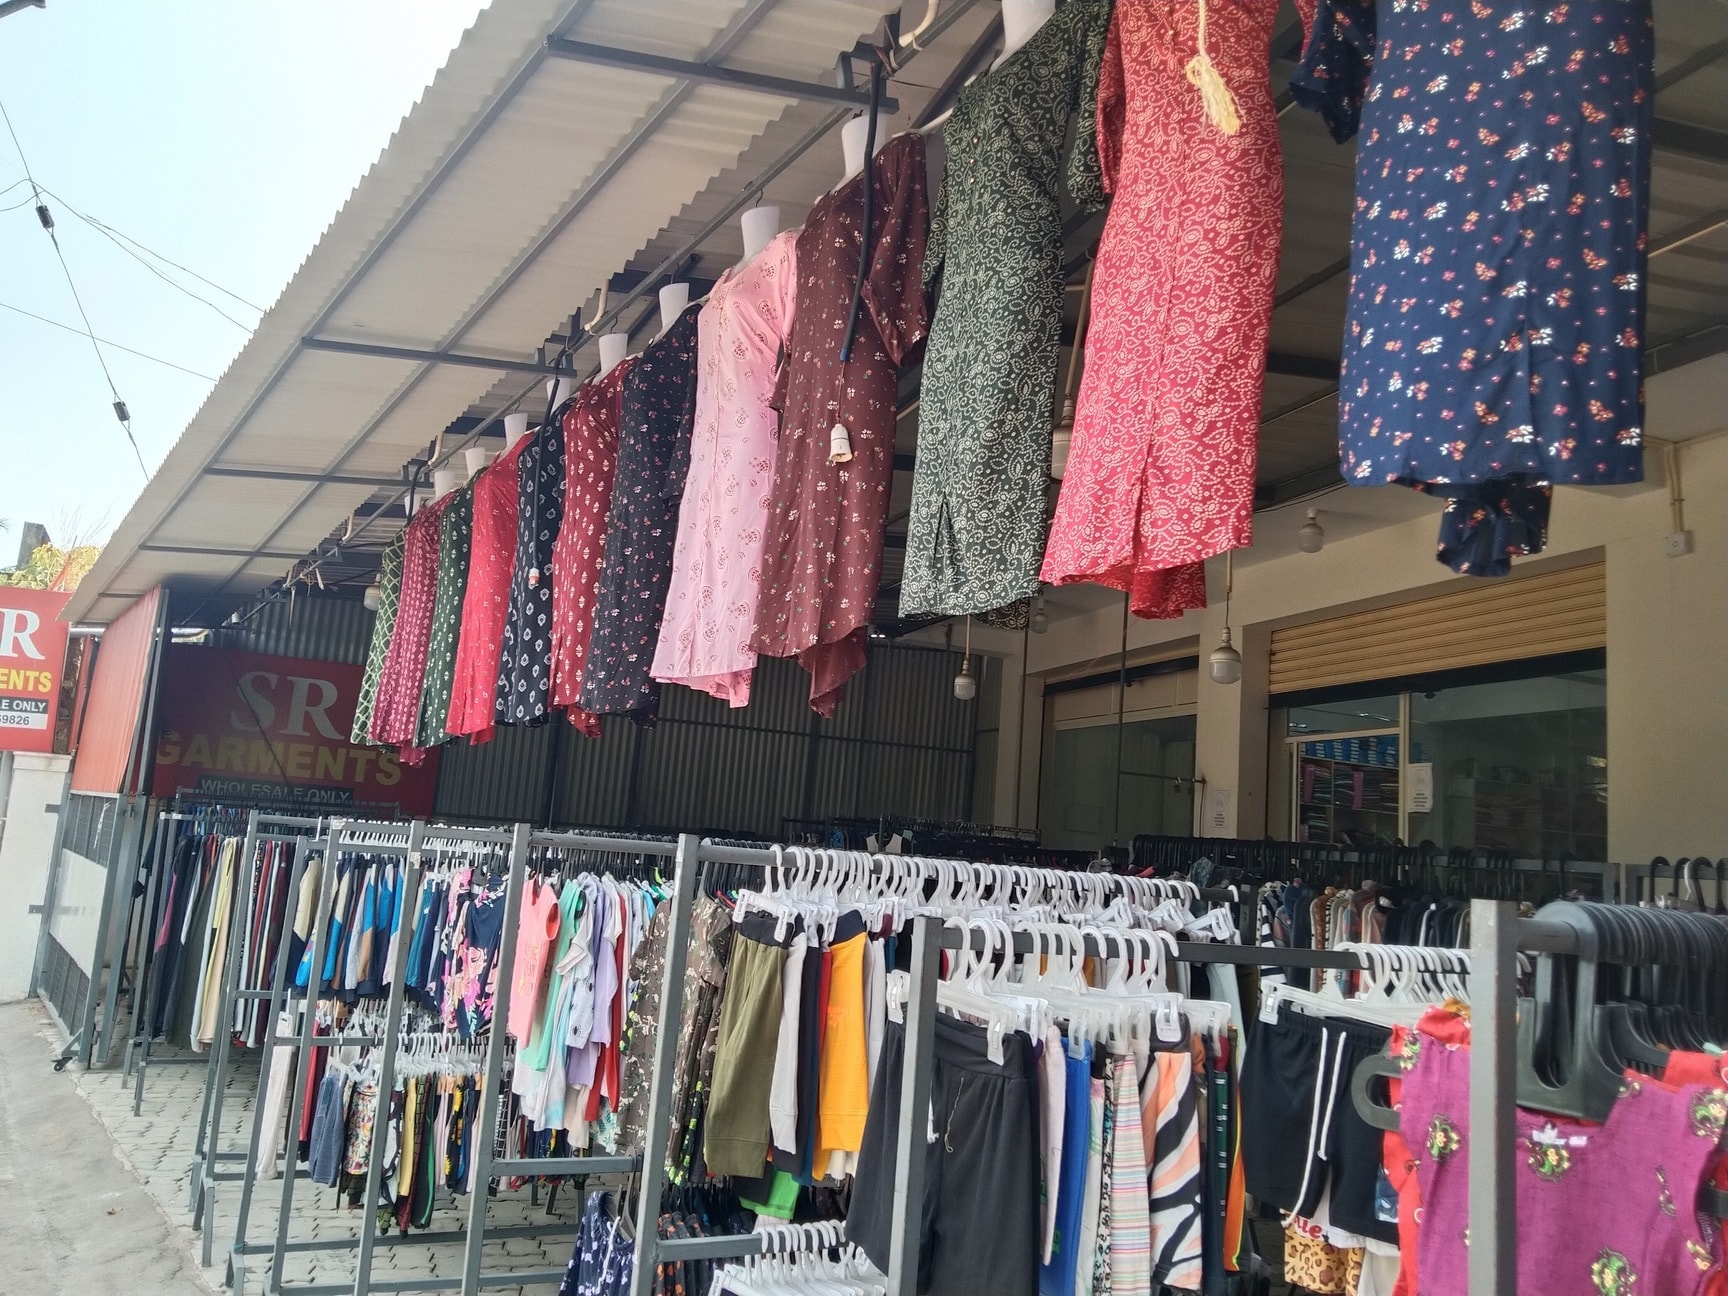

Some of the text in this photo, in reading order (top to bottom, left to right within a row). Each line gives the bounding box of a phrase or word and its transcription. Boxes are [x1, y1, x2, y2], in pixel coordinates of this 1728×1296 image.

[12, 700, 47, 712] ONLY
[230, 671, 345, 740] SR
[155, 730, 402, 786] GARMENTS
[201, 778, 350, 801] WHOLESALE ONLY
